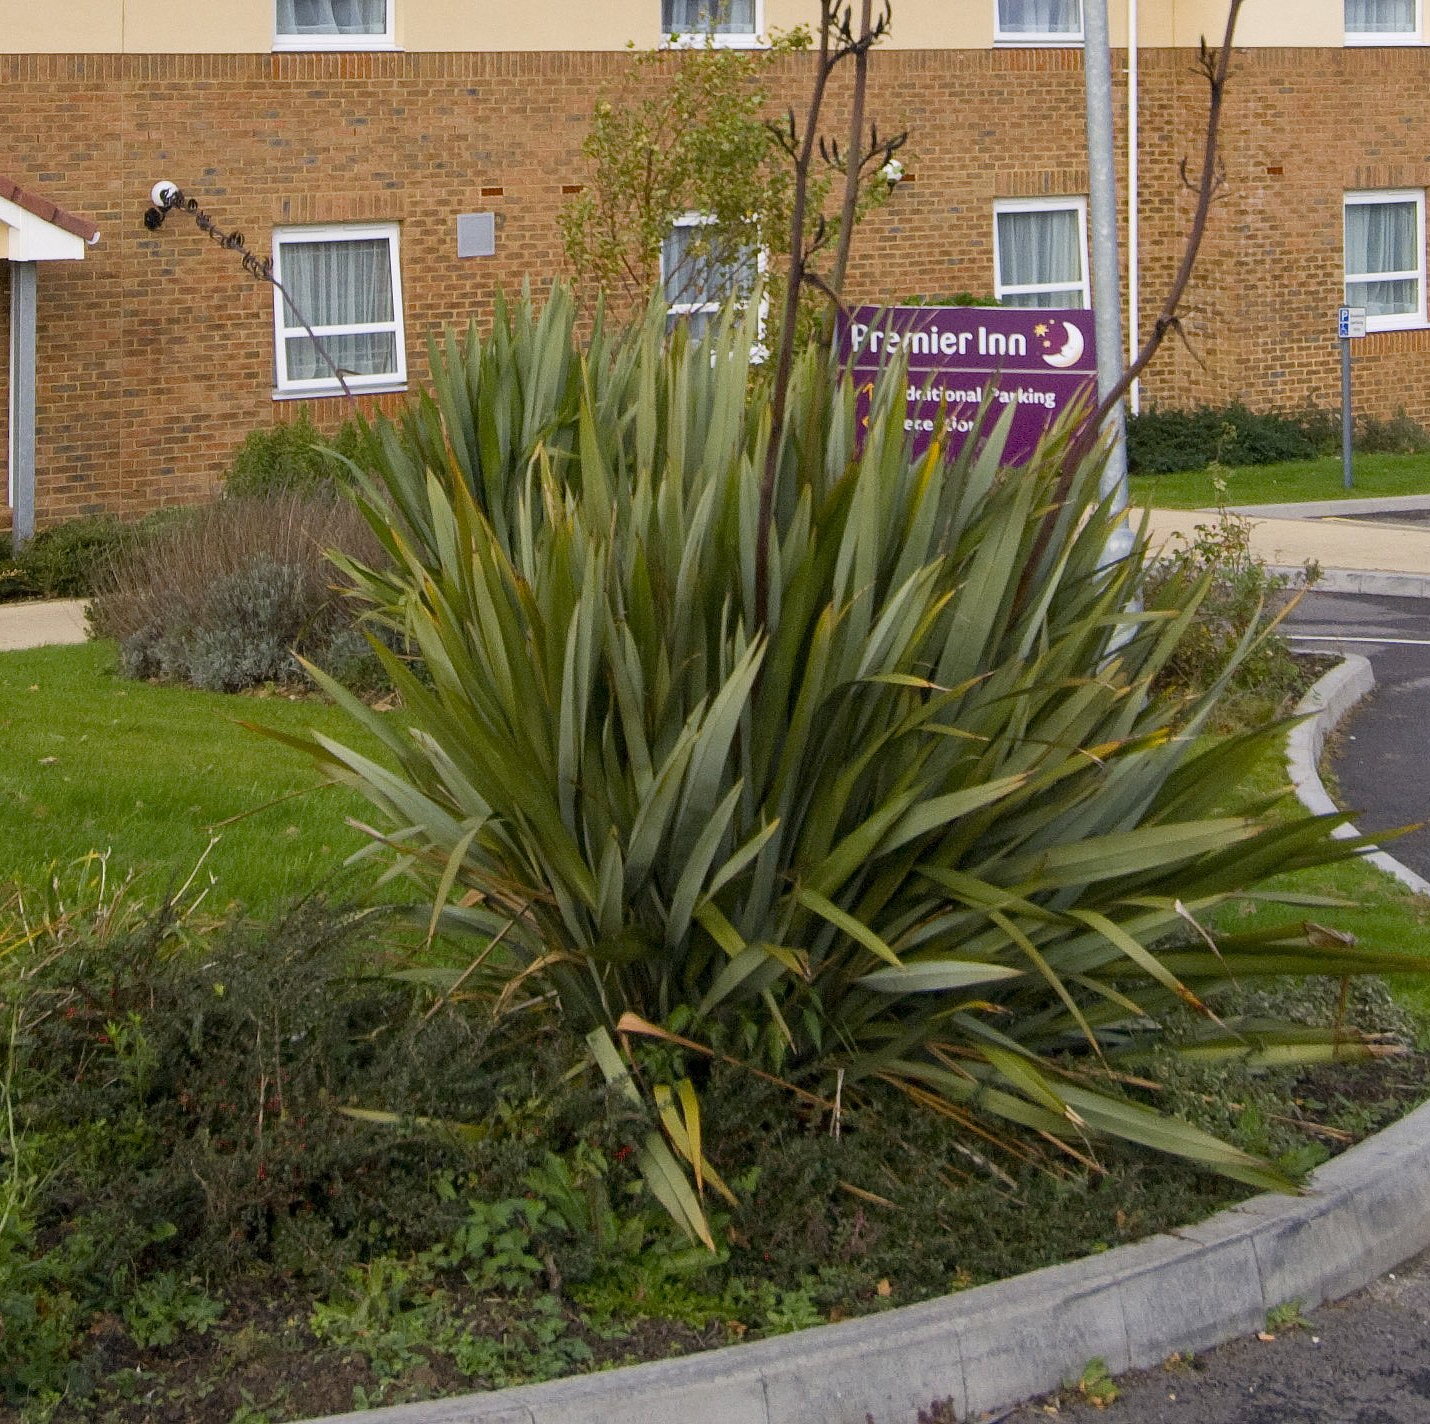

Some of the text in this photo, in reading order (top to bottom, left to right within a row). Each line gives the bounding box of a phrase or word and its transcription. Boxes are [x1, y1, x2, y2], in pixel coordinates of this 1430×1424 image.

[850, 324, 1027, 356] Premier Inn
[899, 385, 982, 403] ditional
[897, 416, 977, 433] ecetio
